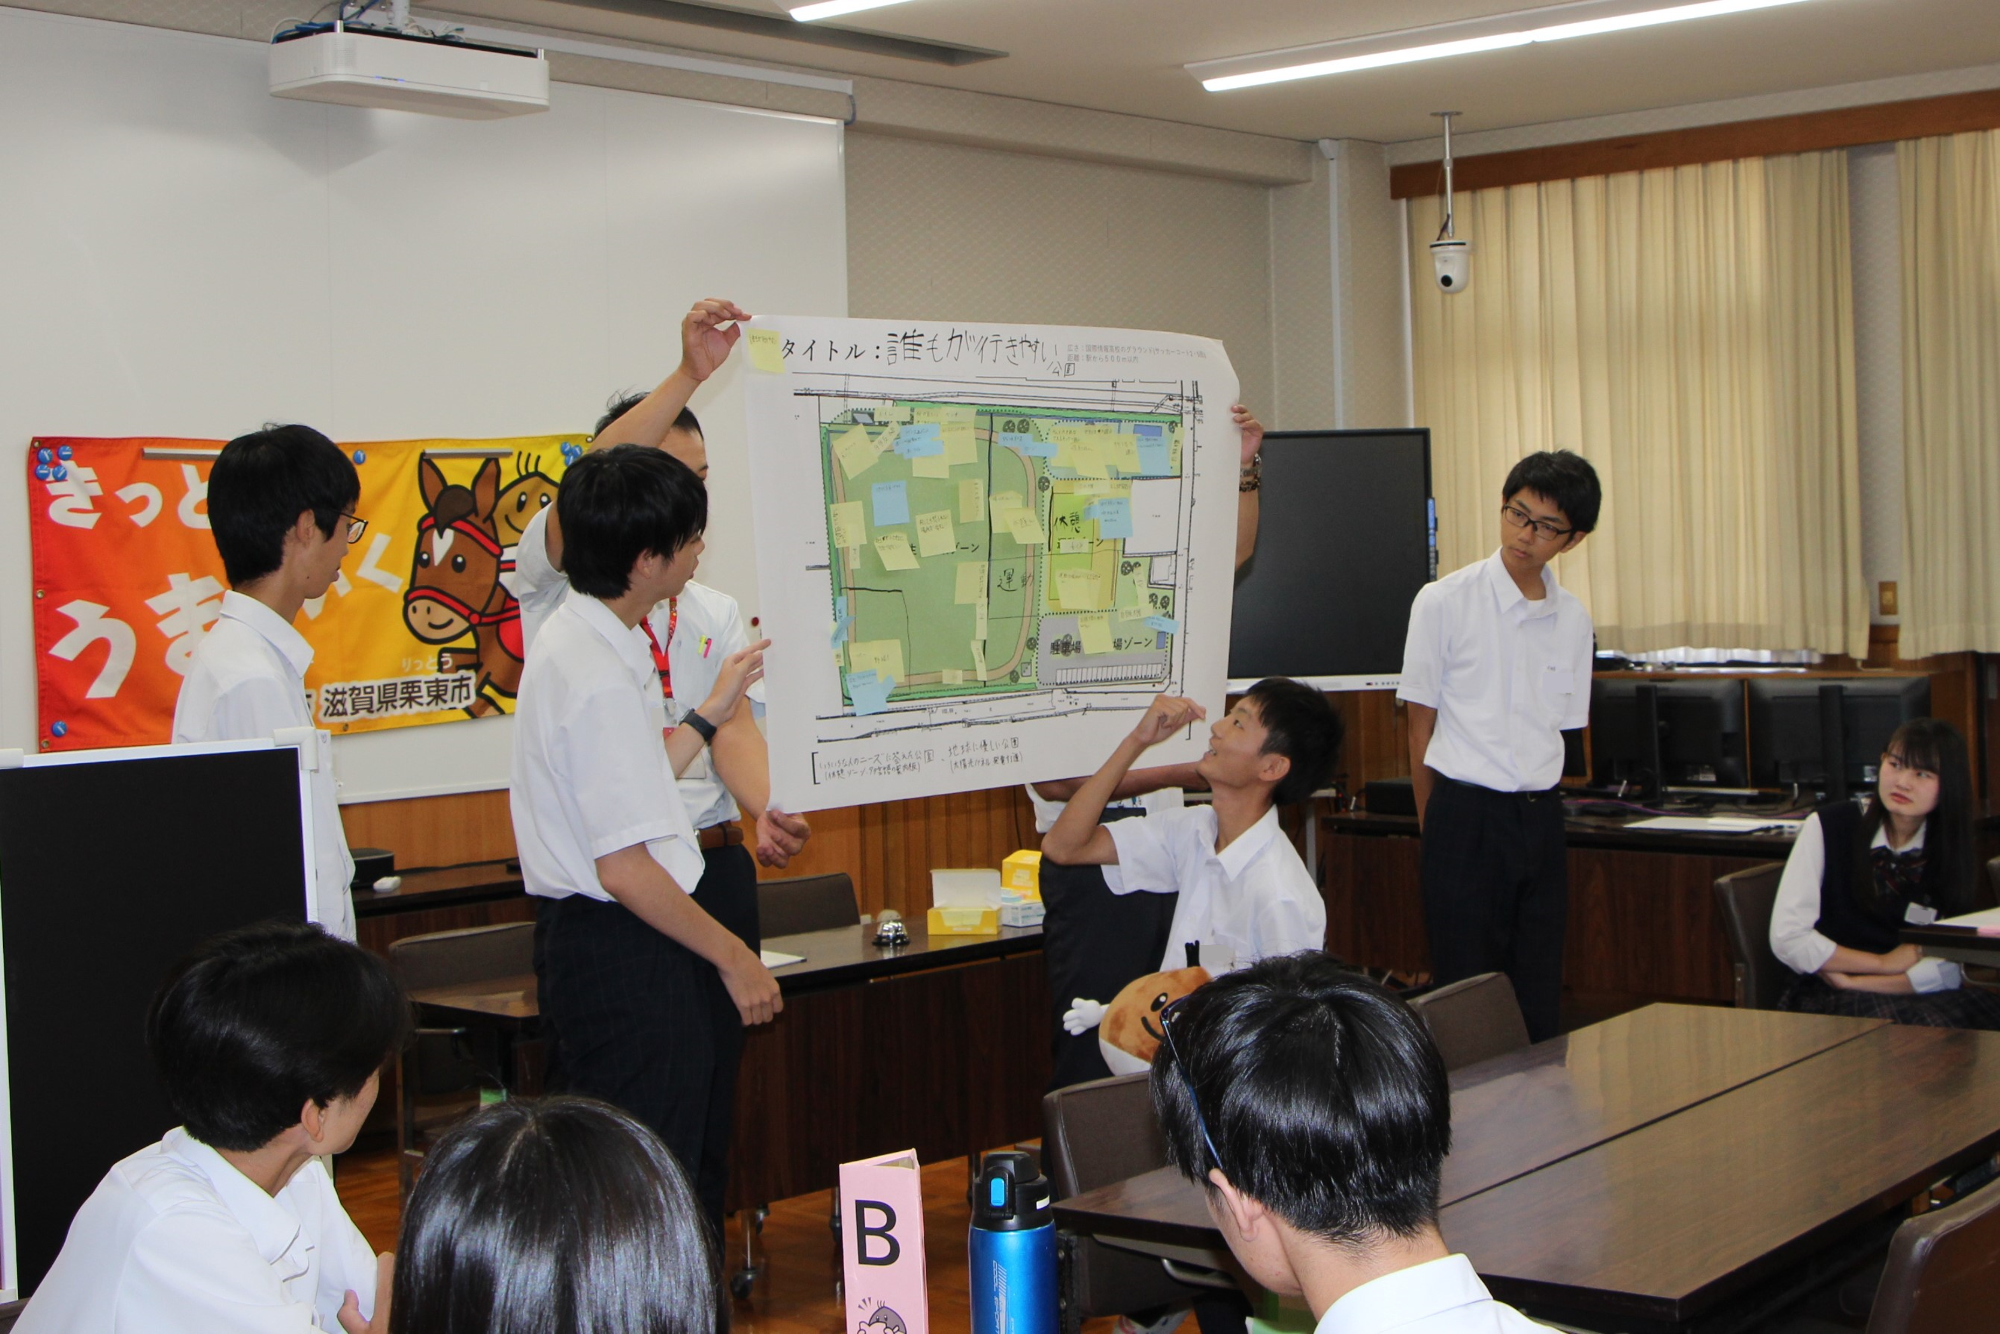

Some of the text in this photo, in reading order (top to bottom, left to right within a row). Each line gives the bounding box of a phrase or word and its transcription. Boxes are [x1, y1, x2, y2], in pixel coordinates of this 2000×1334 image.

[402, 653, 453, 672] りっとう
[324, 675, 472, 718] 滋賀県栗東市
[855, 1199, 901, 1267] B
